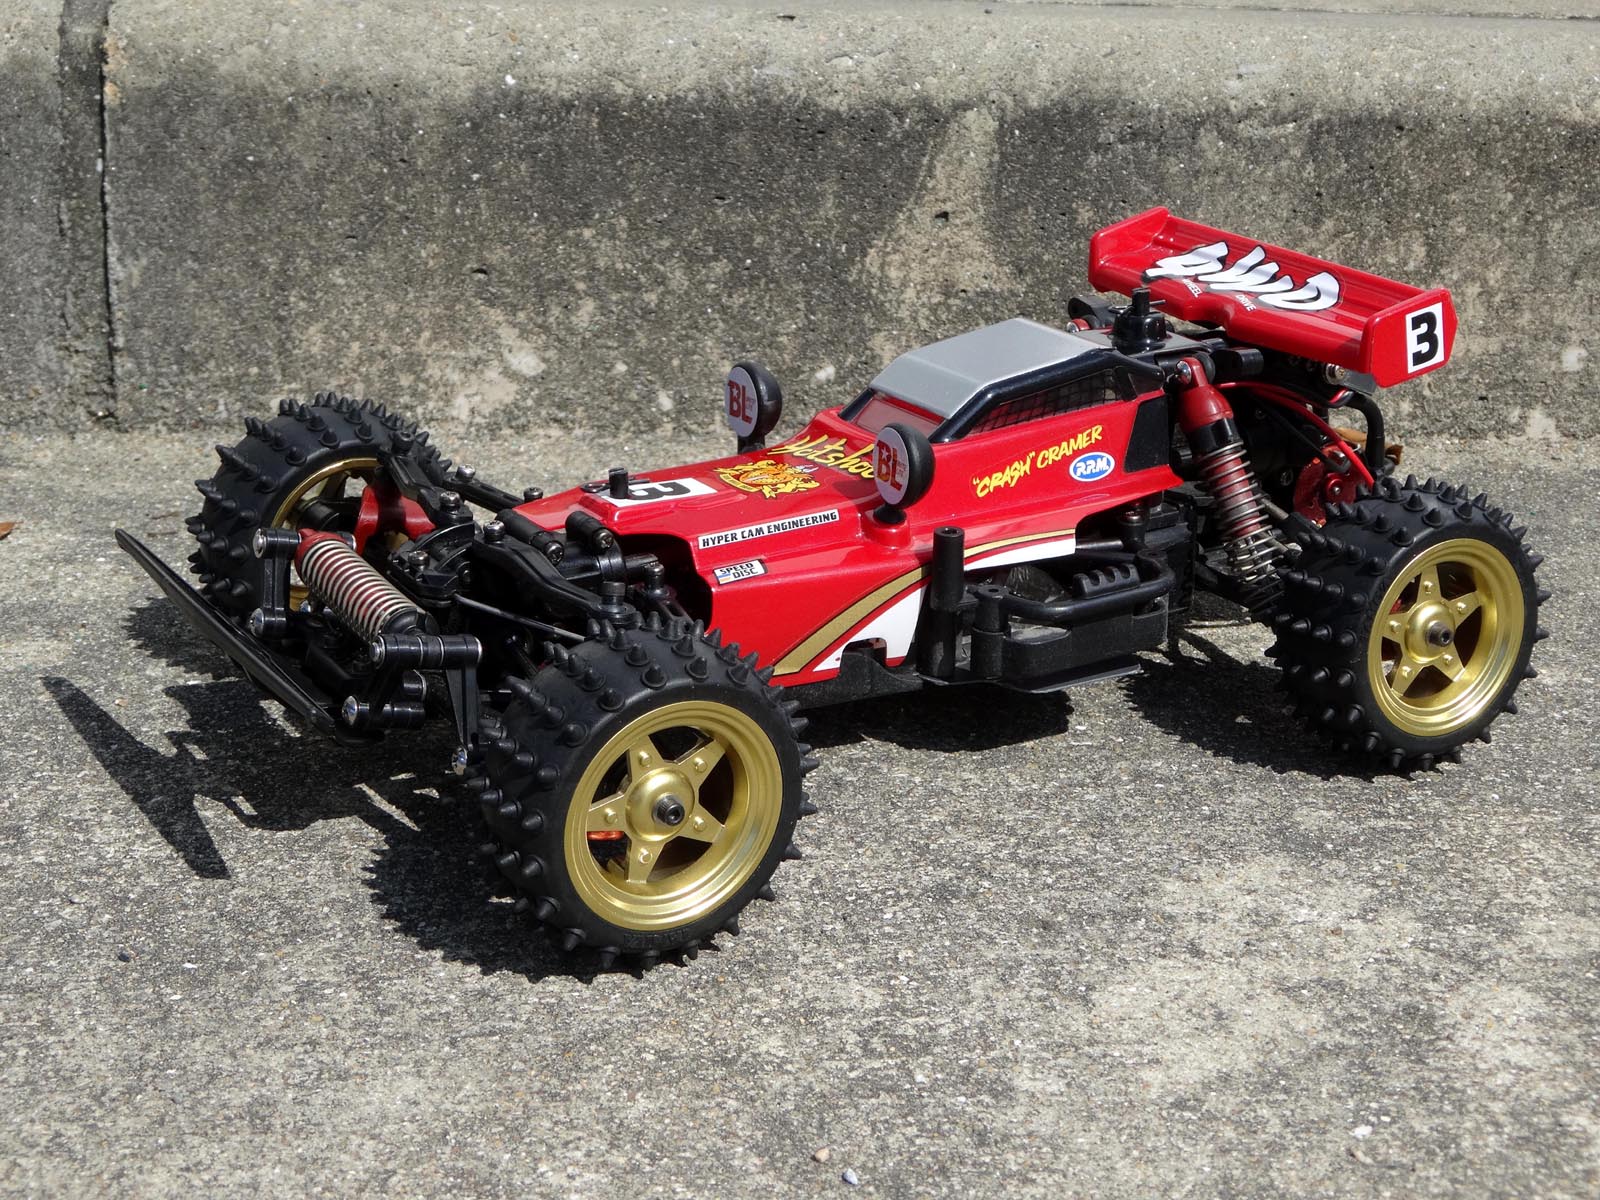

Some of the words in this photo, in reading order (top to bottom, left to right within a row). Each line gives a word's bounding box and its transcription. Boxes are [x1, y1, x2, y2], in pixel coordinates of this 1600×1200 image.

[1235, 294, 1257, 312] DRIVE
[1411, 310, 1440, 367] 3
[1036, 424, 1103, 469] CRAMER
[876, 439, 903, 491] BL
[628, 481, 692, 501] 3
[702, 532, 738, 548] HYPER
[740, 526, 765, 540] CAM
[767, 511, 838, 535] ENGINEERING
[719, 562, 754, 575] SPEED
[732, 567, 759, 579] DISC
